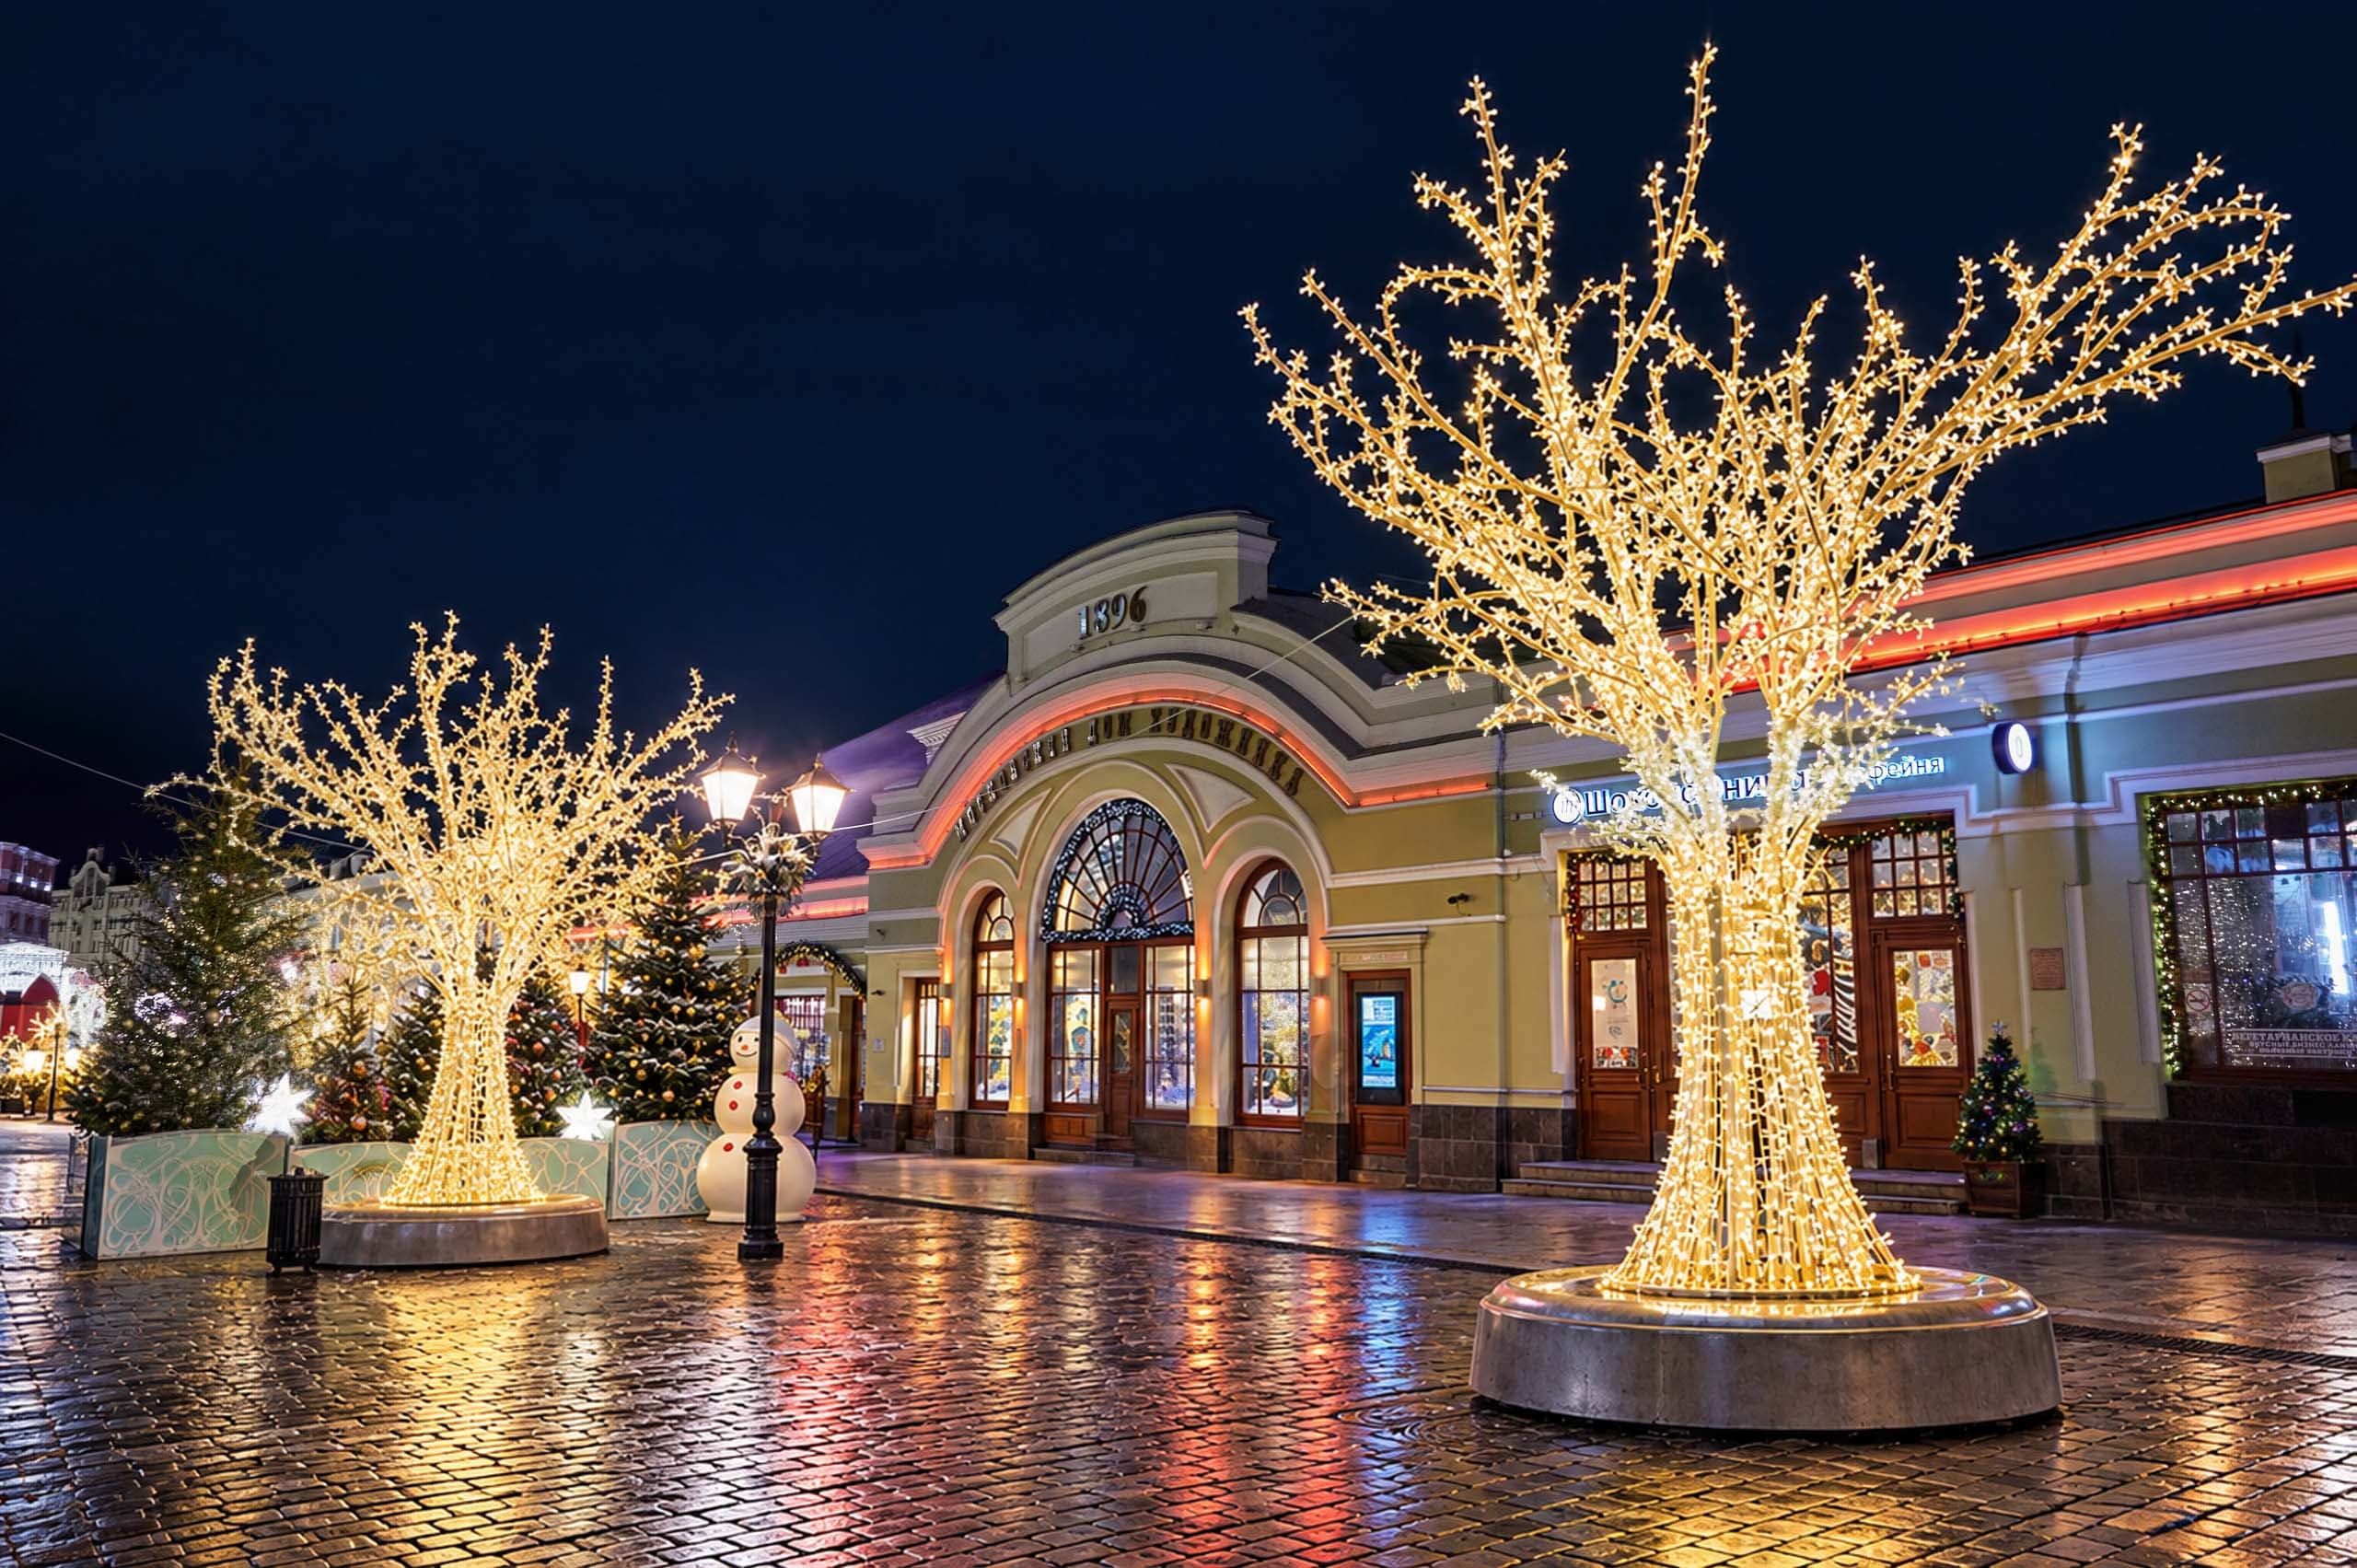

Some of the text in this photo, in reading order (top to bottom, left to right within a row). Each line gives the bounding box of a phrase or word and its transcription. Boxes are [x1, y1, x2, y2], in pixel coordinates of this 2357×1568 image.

[1077, 586, 1149, 640] 1896
[1087, 712, 1132, 746] ДОМ
[1148, 706, 1306, 797] ХУДОЖНИКА
